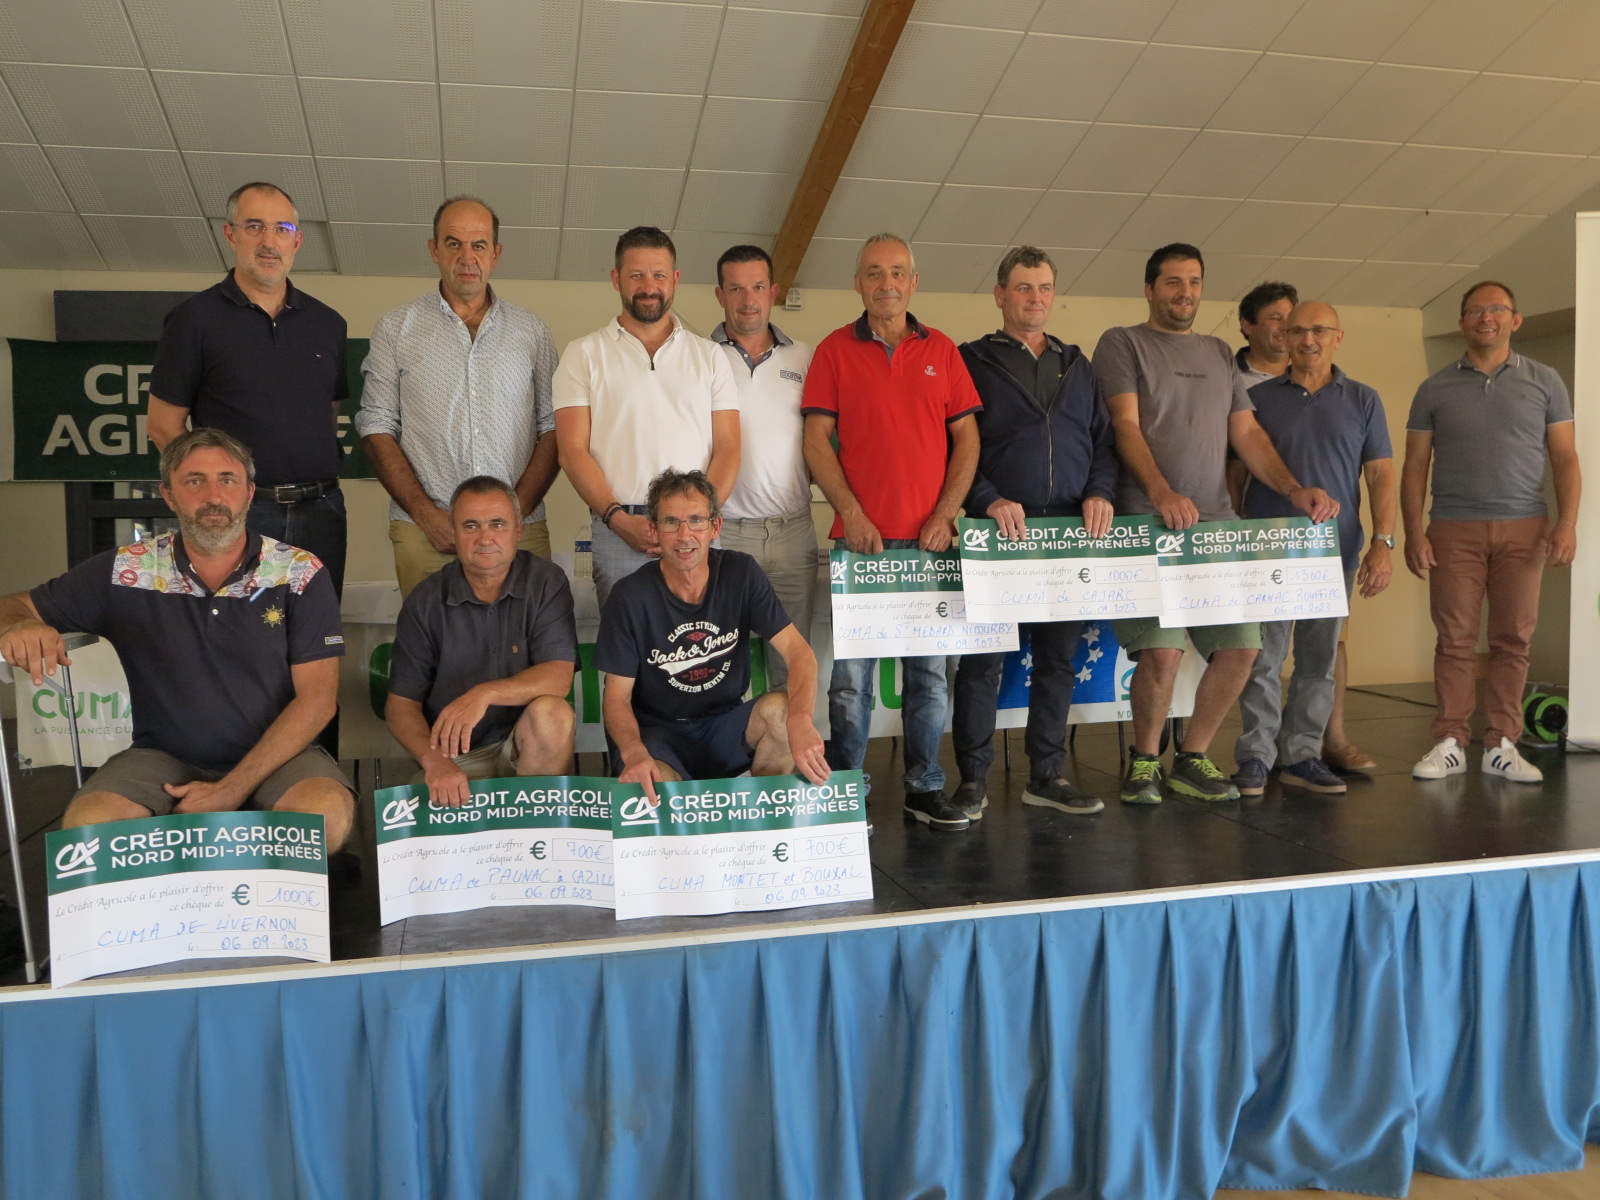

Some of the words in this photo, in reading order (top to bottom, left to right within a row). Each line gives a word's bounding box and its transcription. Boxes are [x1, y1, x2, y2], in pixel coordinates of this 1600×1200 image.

[1063, 525, 1150, 539] AGCOLE
[1191, 529, 1252, 544] CRÉDIT
[1256, 526, 1334, 541] AGRICOLE
[998, 542, 1037, 551] NORD
[1042, 538, 1151, 550] MIDI-PYRÉNÉES
[1193, 544, 1232, 555] NORD
[1236, 539, 1335, 553] MIDI-PYRÉNÉES
[854, 558, 920, 572] CRÉDIT
[923, 560, 960, 572] AGRI
[989, 570, 1015, 579] Agricole
[1030, 568, 1049, 578] plaisir
[854, 574, 896, 584] NORD
[901, 573, 961, 582] MIDI-PYR
[1078, 568, 1091, 584] €
[1184, 573, 1210, 583] Agricole
[1270, 569, 1283, 585] €
[1057, 590, 1070, 602] de
[846, 602, 872, 612] Agricole
[886, 602, 908, 612] plaisir
[936, 602, 948, 618] €
[668, 622, 694, 642] CLASSIC
[696, 621, 720, 635] STYLING
[647, 645, 686, 664] Jack
[701, 628, 739, 656] Jones
[668, 676, 702, 692] SUPERIOR
[703, 672, 726, 690] DENIM
[34, 727, 48, 735] LA
[52, 727, 110, 735] PUISANCE
[428, 791, 510, 810] CDIT
[669, 791, 751, 810] CRÉDIT
[756, 783, 859, 806] AGRICOLE
[429, 810, 482, 824] NORD
[670, 810, 723, 824] NORD
[728, 798, 860, 821] MIDI-PYRÉNÉES
[110, 827, 208, 852] CRÉDIT
[214, 825, 322, 846] AGRICOLE
[112, 850, 175, 869] NORD
[182, 843, 322, 861] MIDI-PYRÉNÉES
[382, 856, 392, 864] Le
[392, 850, 414, 862] Crédit
[416, 847, 450, 862] Agricole
[460, 845, 468, 854] le
[468, 844, 493, 856] plaisir
[496, 840, 524, 852] d'offrir
[530, 840, 546, 860] €
[620, 850, 630, 859] Le
[632, 847, 658, 858] Crédit
[659, 846, 692, 860] Agricole
[702, 846, 708, 854] le
[709, 845, 736, 858] plaisir
[738, 843, 766, 855] d'offrir
[772, 842, 788, 862] €
[486, 856, 512, 868] chèque
[514, 854, 523, 862] de
[729, 858, 755, 870] chèque
[758, 857, 766, 866] de
[408, 873, 462, 894] CUMA
[658, 874, 705, 890] CUMA
[784, 872, 795, 885] et
[55, 906, 66, 918] Le
[67, 899, 94, 914] Crédit
[96, 893, 137, 910] Agricole
[148, 889, 158, 900] le
[158, 886, 190, 903] plaisir
[192, 883, 225, 898] d'offrir
[231, 884, 250, 906] €
[169, 904, 180, 912] ce
[181, 899, 212, 914] chèque
[214, 899, 225, 909] de
[98, 922, 162, 948] CUMA
